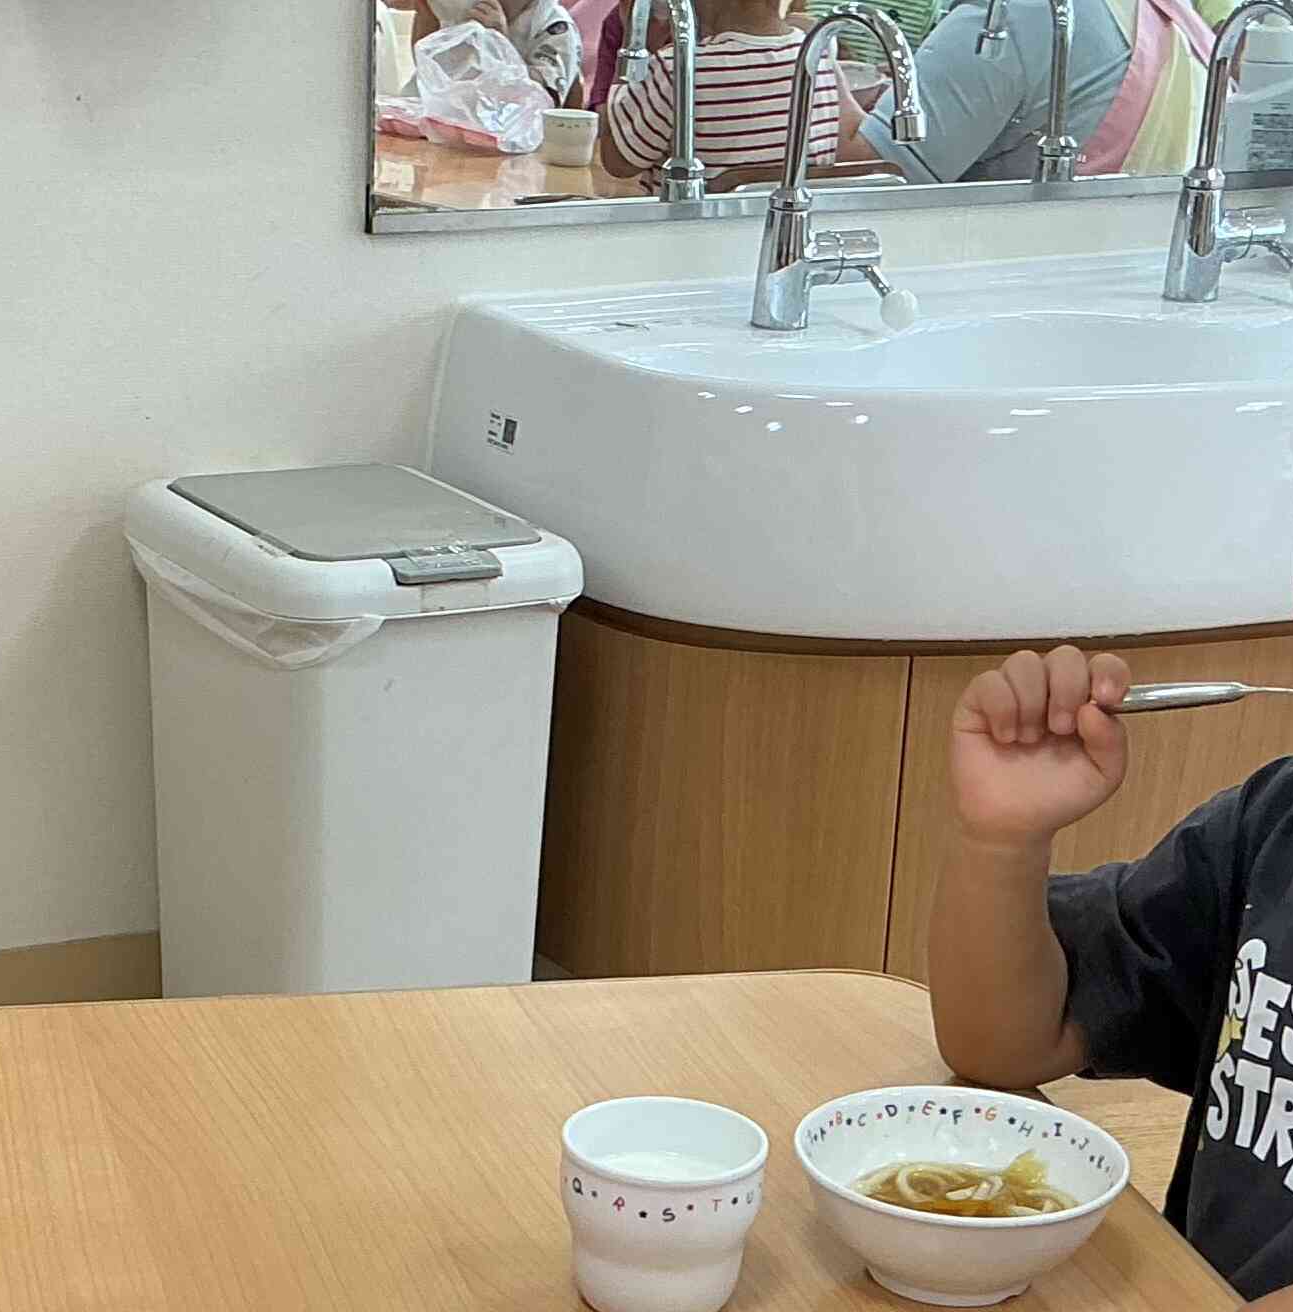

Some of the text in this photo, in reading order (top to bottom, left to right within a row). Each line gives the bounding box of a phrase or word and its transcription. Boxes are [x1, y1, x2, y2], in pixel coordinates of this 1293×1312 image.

[835, 1111, 843, 1125] B
[857, 1114, 867, 1127] C
[885, 1104, 898, 1117] D
[921, 1100, 936, 1116] E
[952, 1109, 963, 1125] F
[984, 1105, 998, 1121] G
[1018, 1121, 1034, 1137] H
[1054, 1122, 1063, 1137] I
[1078, 1138, 1090, 1150] J
[572, 1177, 584, 1196] Q
[613, 1196, 625, 1211] R
[662, 1208, 676, 1222] S
[712, 1199, 723, 1212] T
